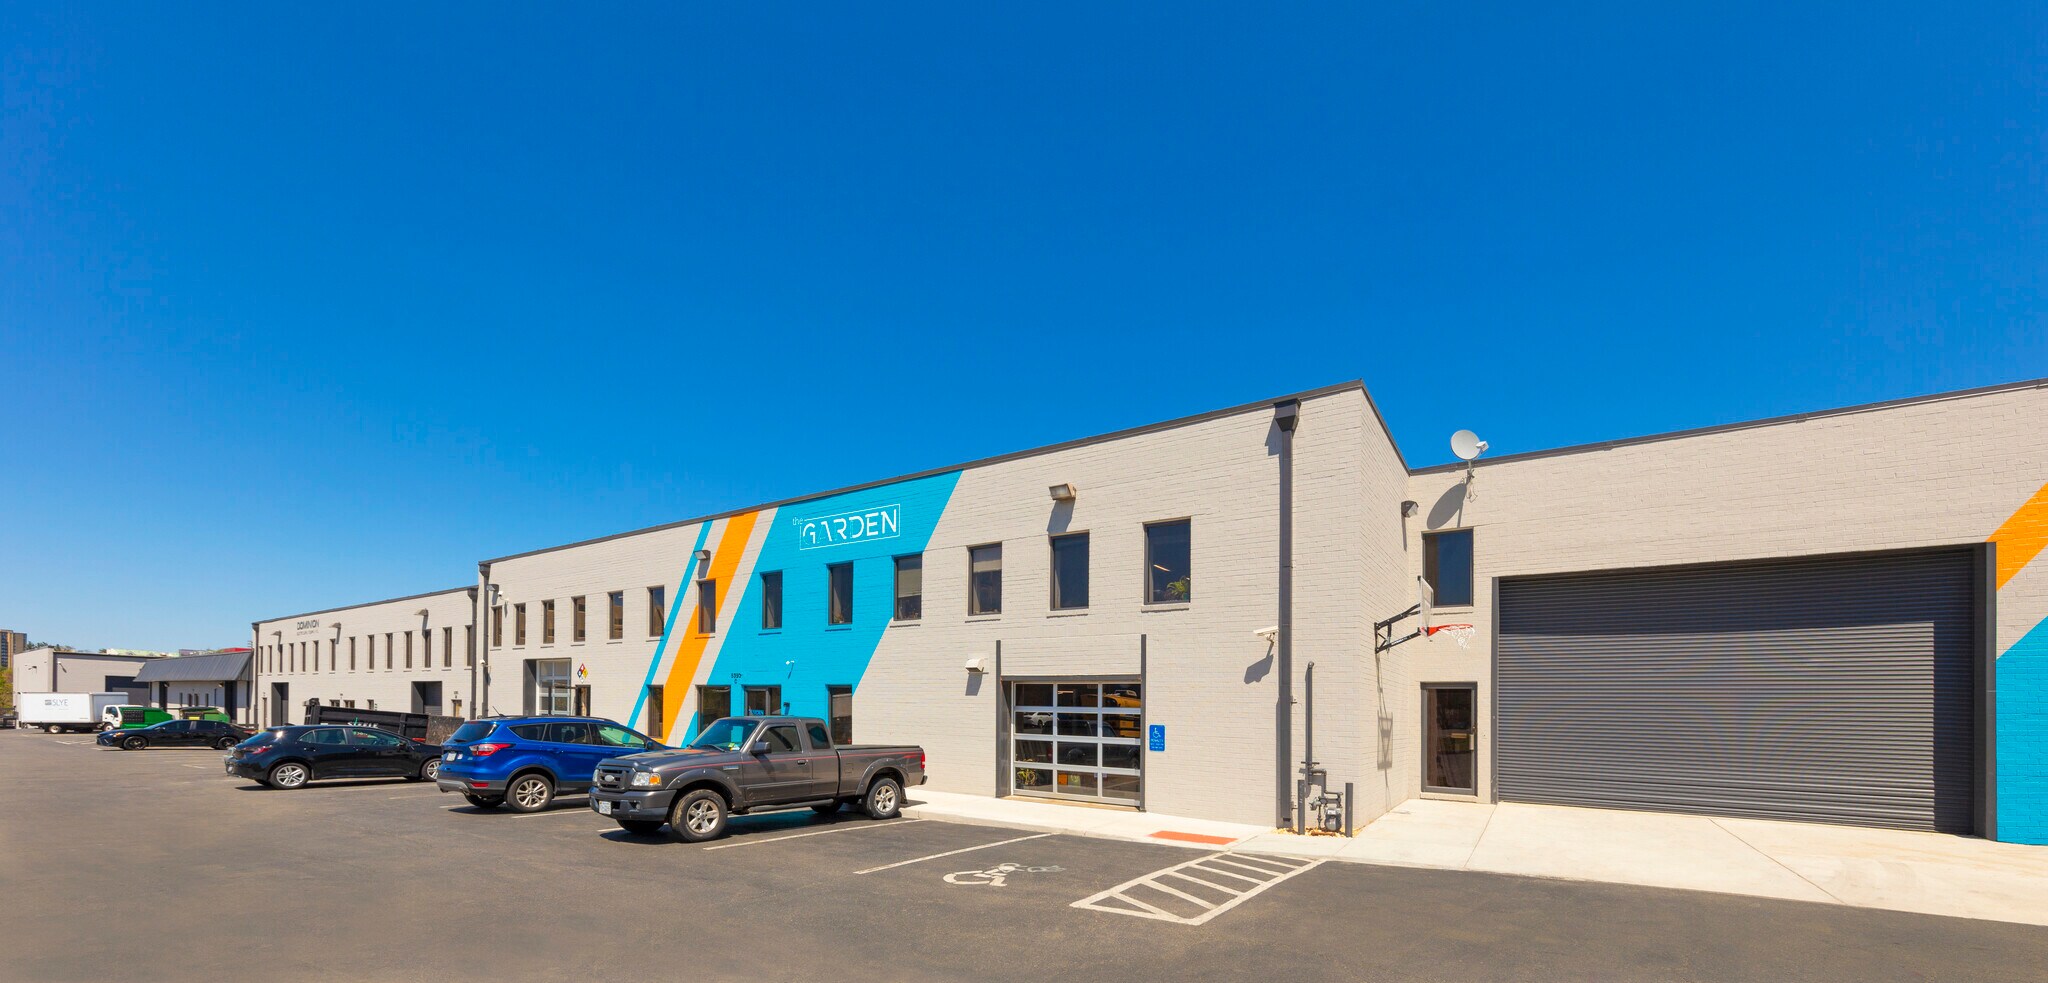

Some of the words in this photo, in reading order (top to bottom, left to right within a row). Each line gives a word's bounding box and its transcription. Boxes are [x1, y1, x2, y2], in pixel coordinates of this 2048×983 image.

[792, 517, 803, 525] the
[803, 508, 897, 545] GARDEN
[297, 619, 320, 630] DOMINION
